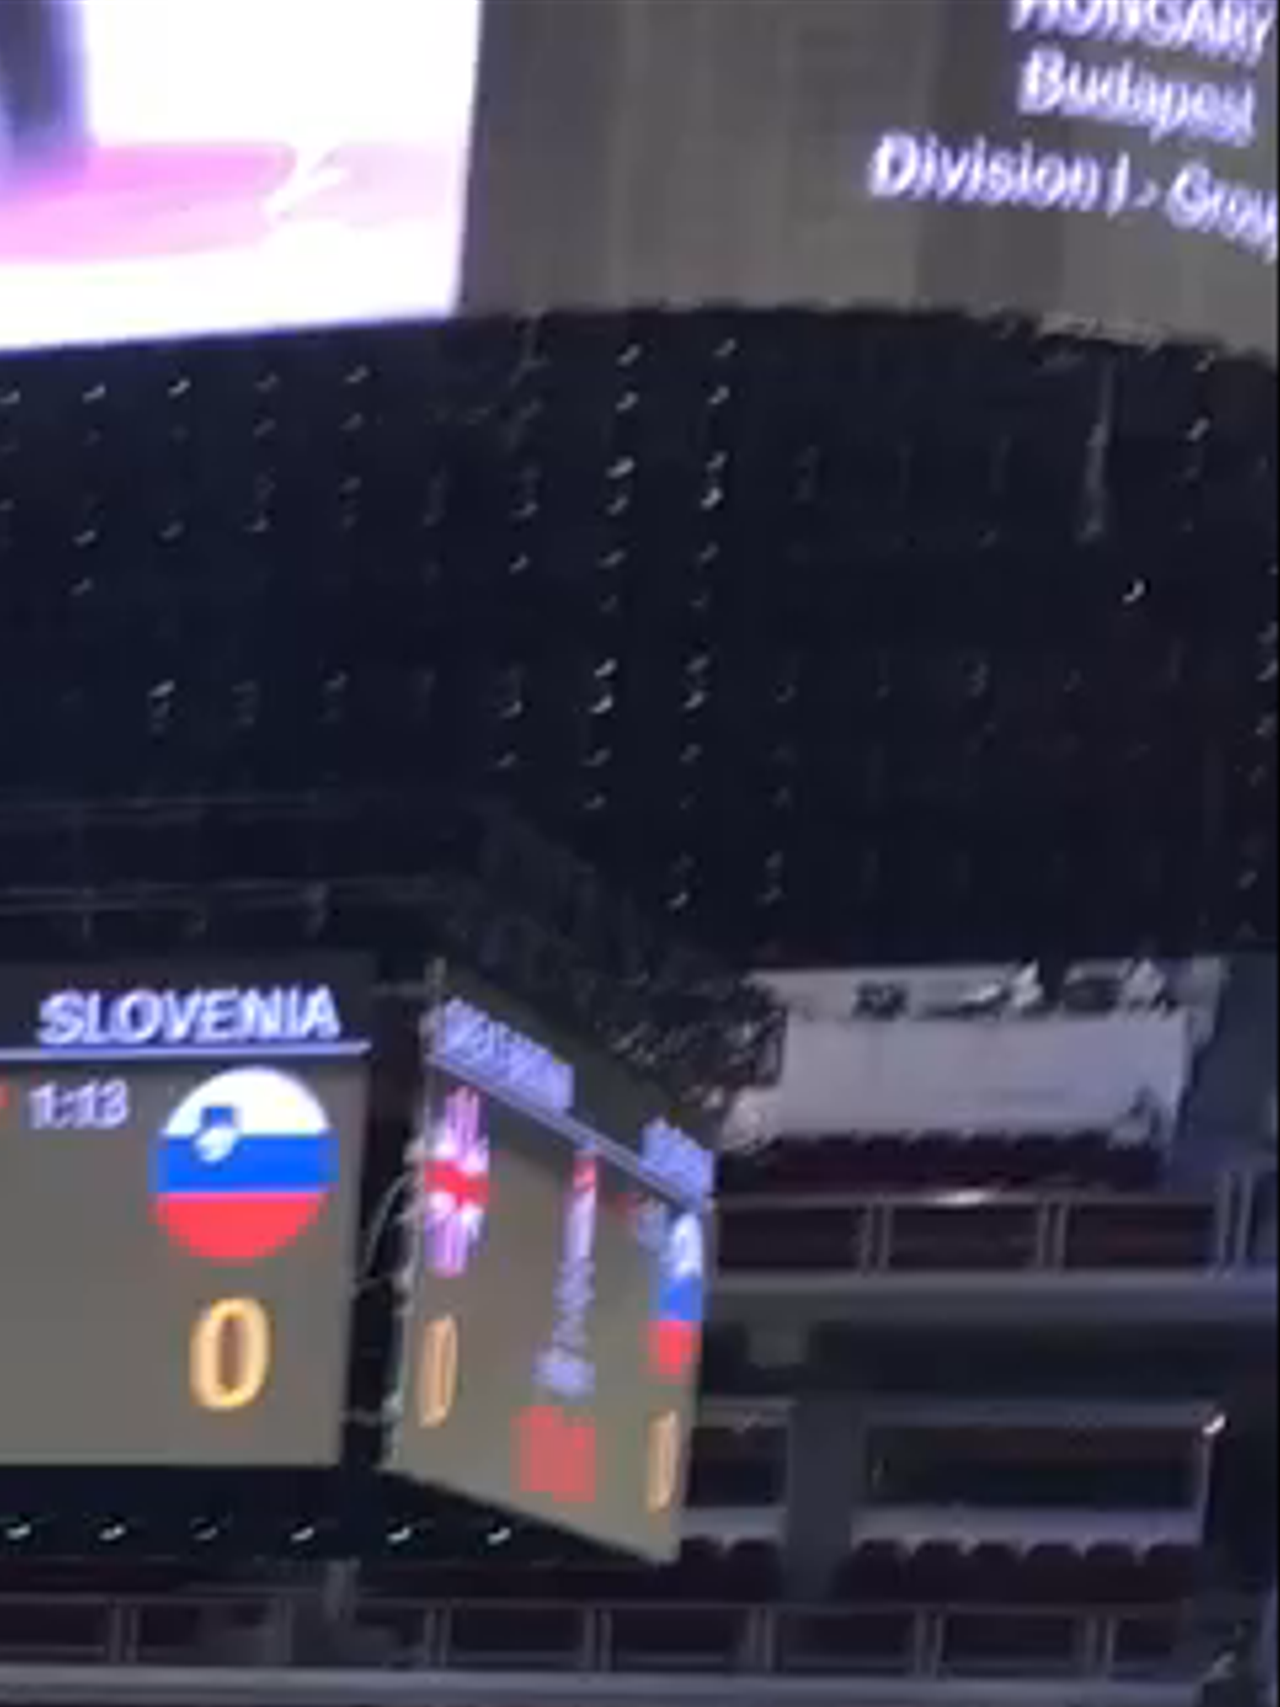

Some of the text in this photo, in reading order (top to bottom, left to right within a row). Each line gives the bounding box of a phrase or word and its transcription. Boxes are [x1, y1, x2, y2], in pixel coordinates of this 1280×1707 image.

[1019, 46, 1255, 147] Budapest
[869, 129, 1101, 211] Division
[1165, 158, 1279, 264] Grou
[40, 985, 342, 1045] SLOVENIA
[30, 1078, 132, 1129] 1:13
[190, 1298, 272, 1410] 0
